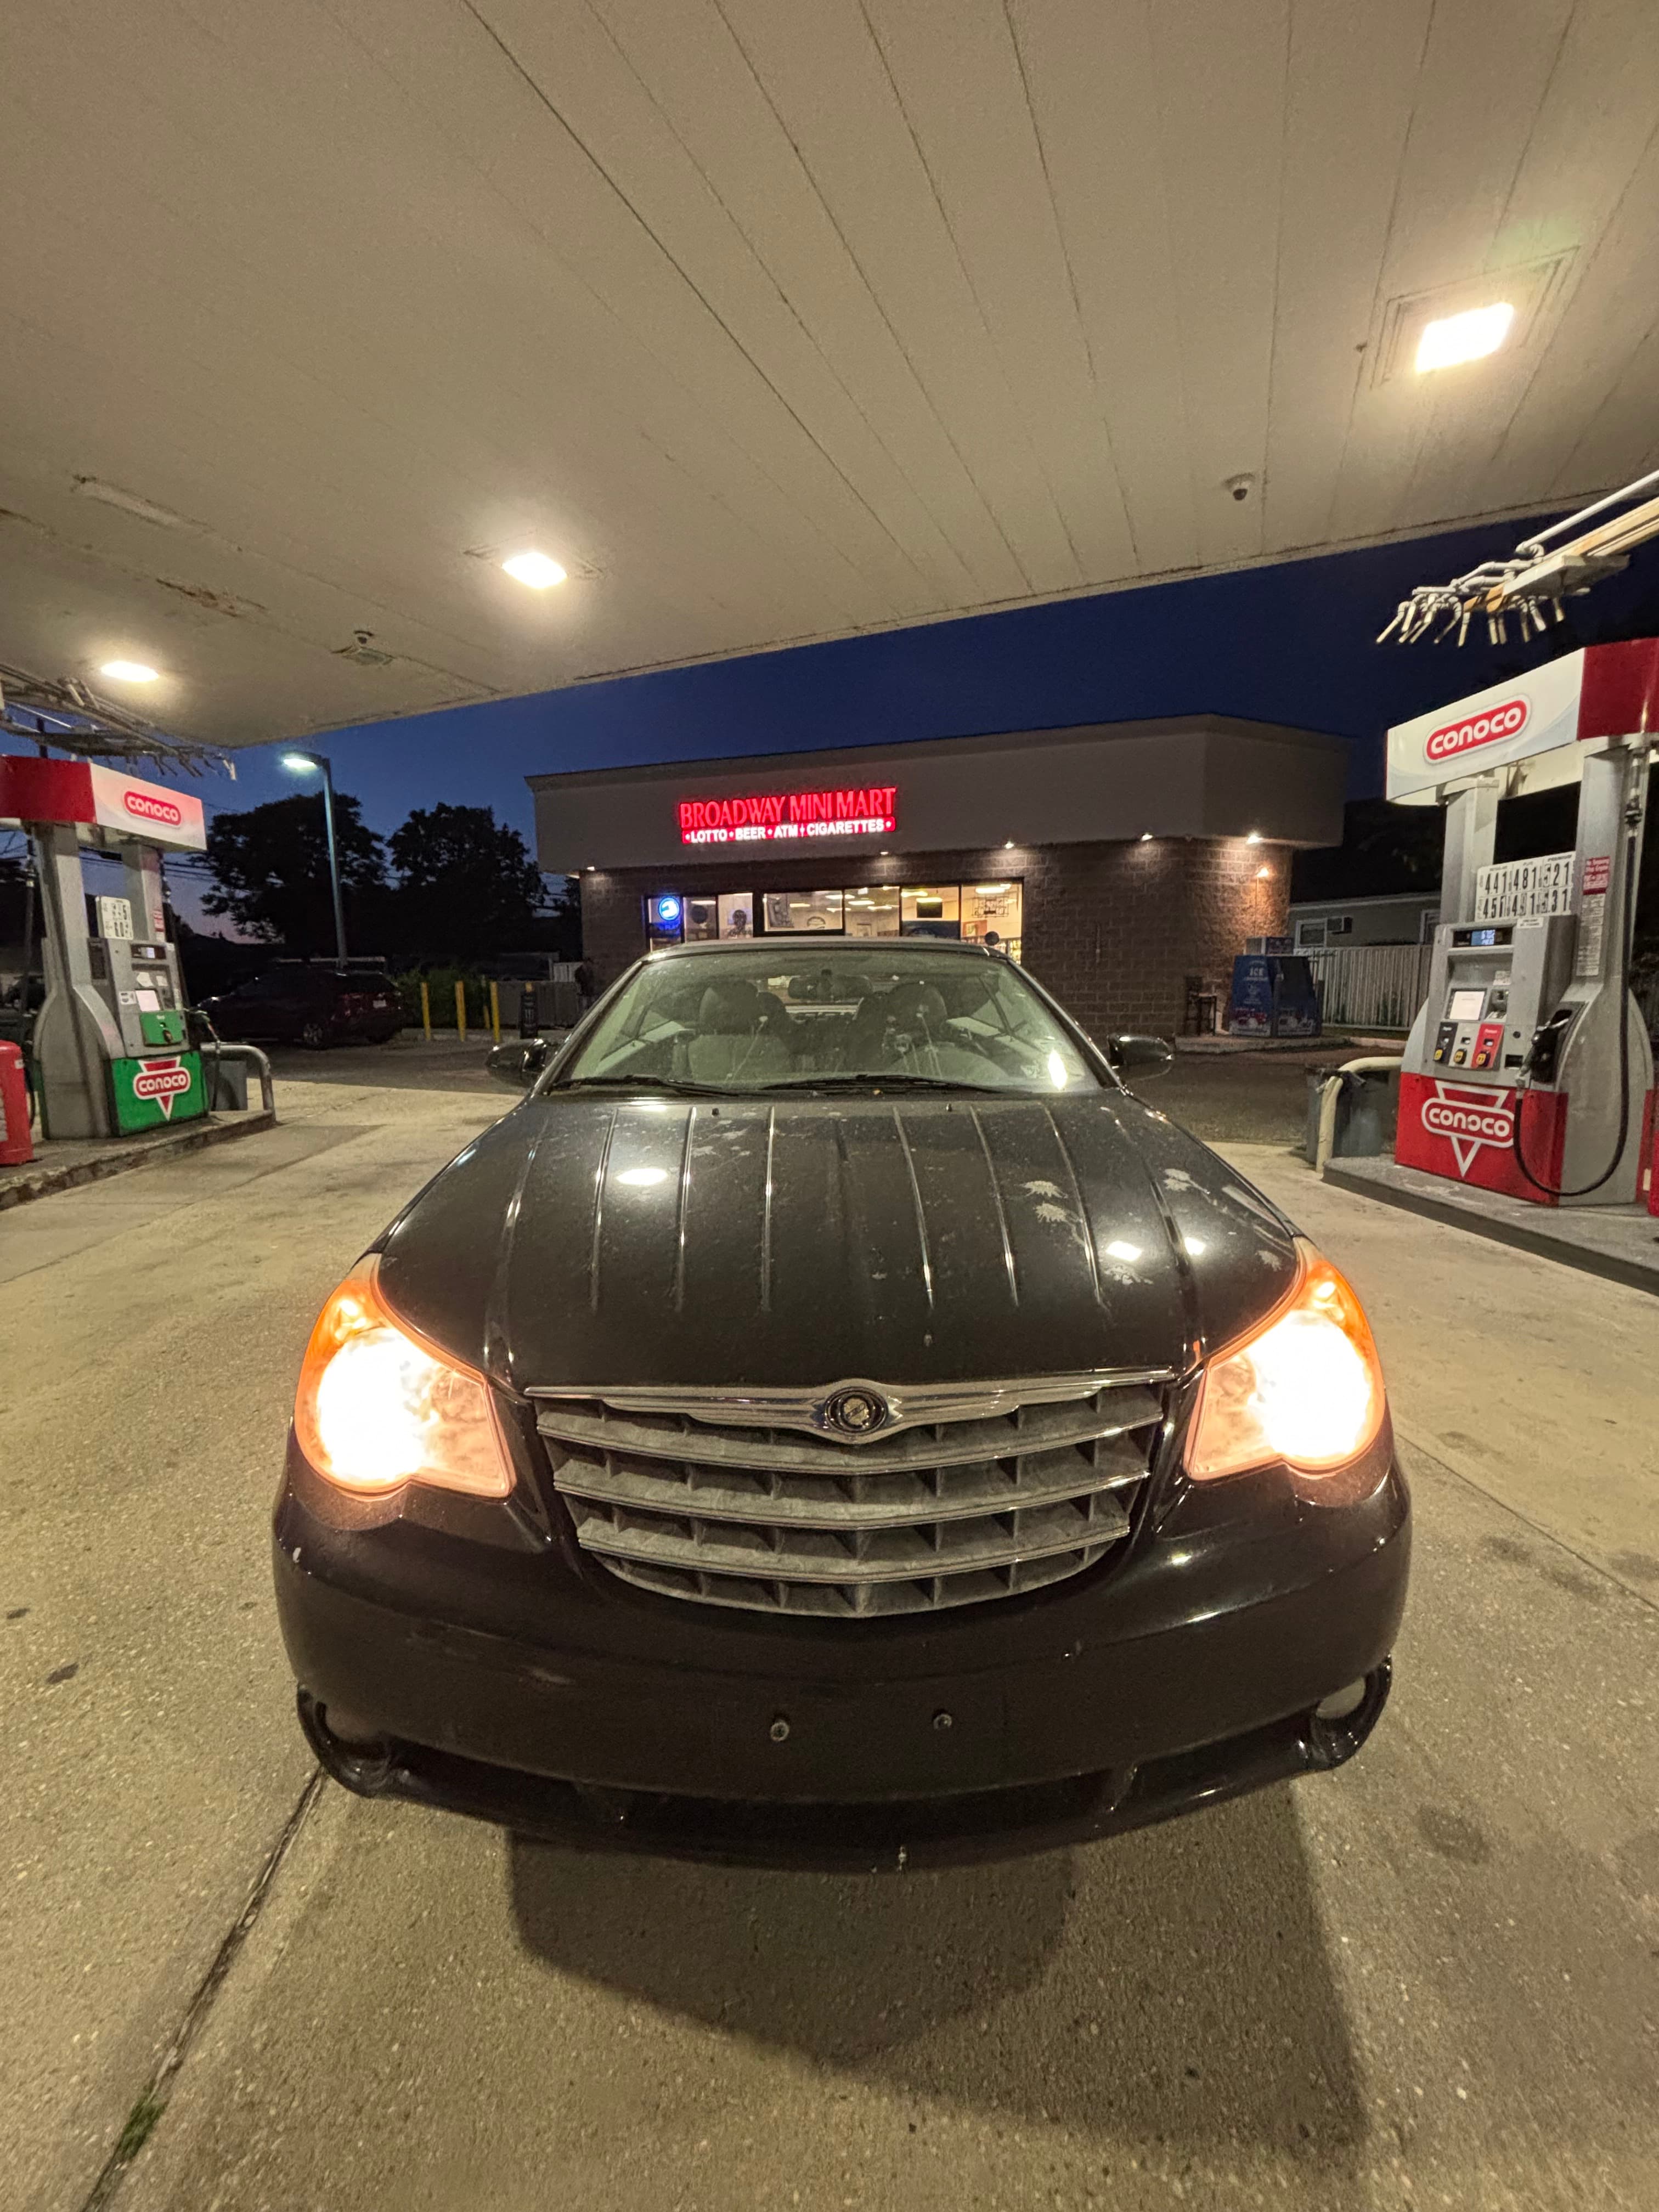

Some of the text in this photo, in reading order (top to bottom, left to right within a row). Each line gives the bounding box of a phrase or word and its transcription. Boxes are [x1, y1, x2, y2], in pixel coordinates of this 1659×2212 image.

[680, 788, 896, 828] BROADWAY MINI MART
[691, 819, 884, 843] LOTTO BEER ATM CIGARETTES
